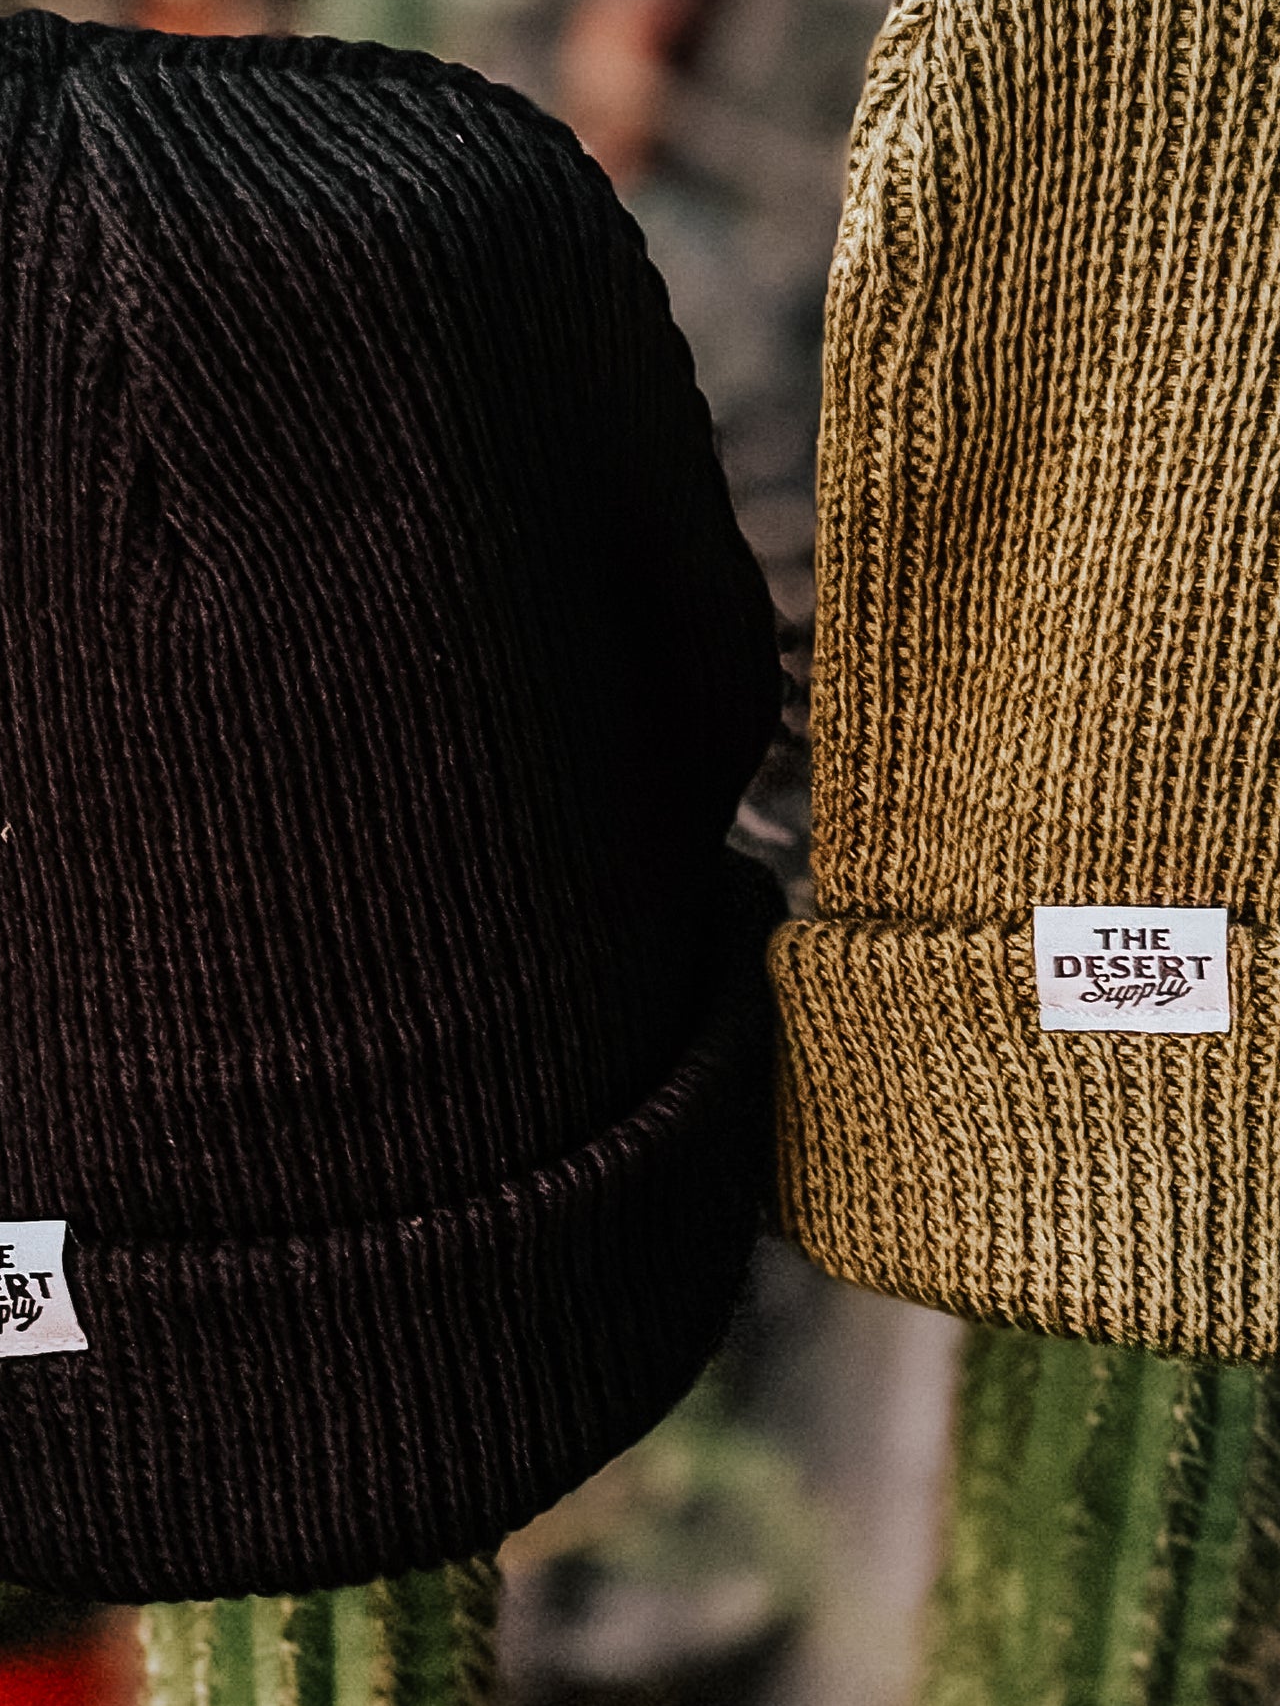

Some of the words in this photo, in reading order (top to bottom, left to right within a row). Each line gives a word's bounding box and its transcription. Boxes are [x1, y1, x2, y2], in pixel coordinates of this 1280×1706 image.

[1093, 928, 1170, 950] THE
[1053, 955, 1212, 979] DESERT
[1080, 974, 1193, 1009] Supply
